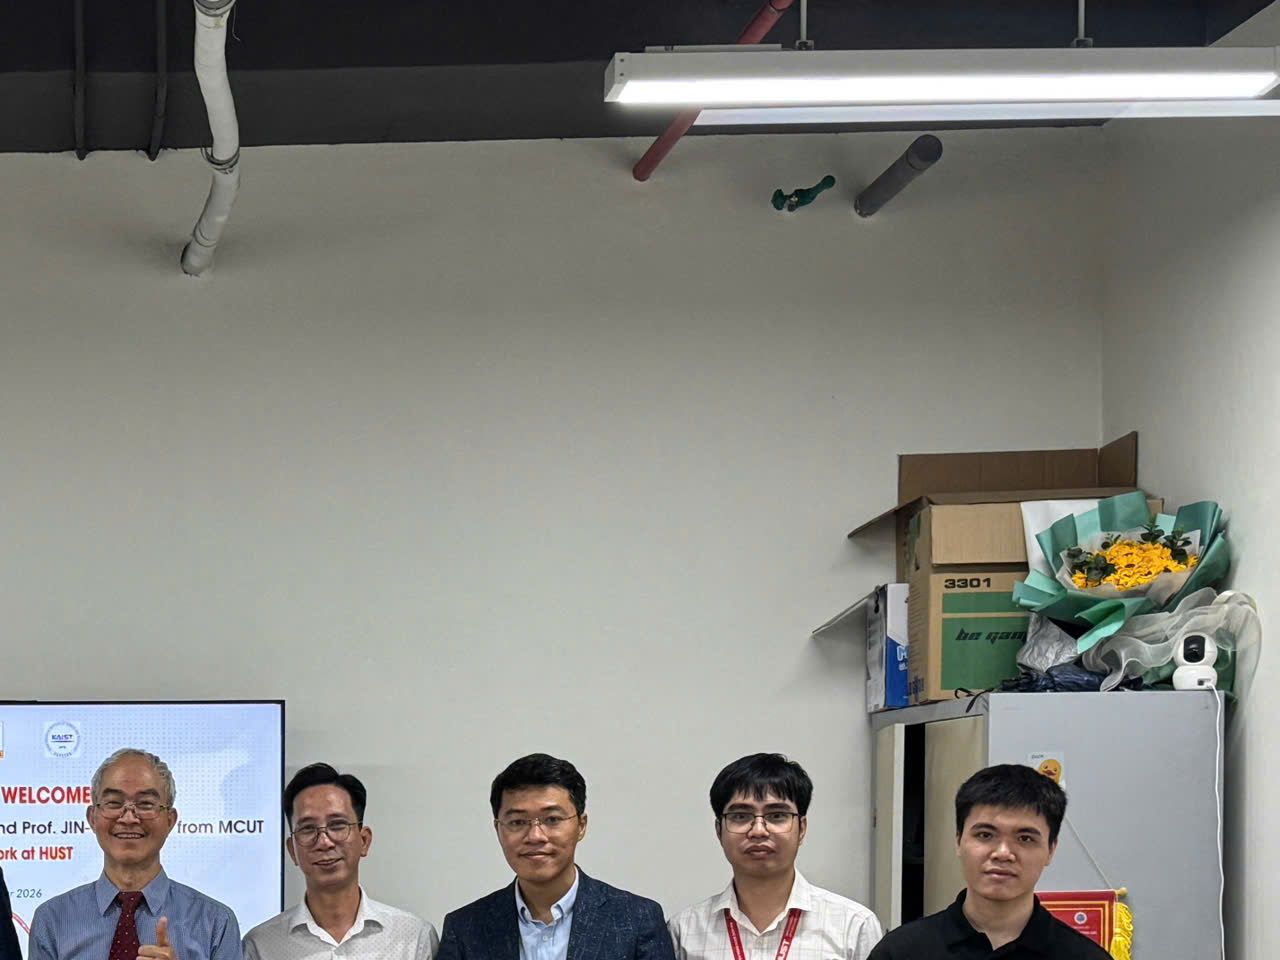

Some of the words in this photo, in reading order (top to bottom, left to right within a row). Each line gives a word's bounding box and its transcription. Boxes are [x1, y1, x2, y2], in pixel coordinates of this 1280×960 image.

[944, 578, 992, 589] 3301
[955, 627, 982, 641] be
[1, 786, 91, 804] WELCOME
[22, 821, 56, 835] Prof.
[177, 819, 214, 834] from
[219, 819, 265, 834] MCUT
[21, 847, 35, 861] at
[39, 846, 74, 861] HUST
[16, 888, 43, 899] 2026
